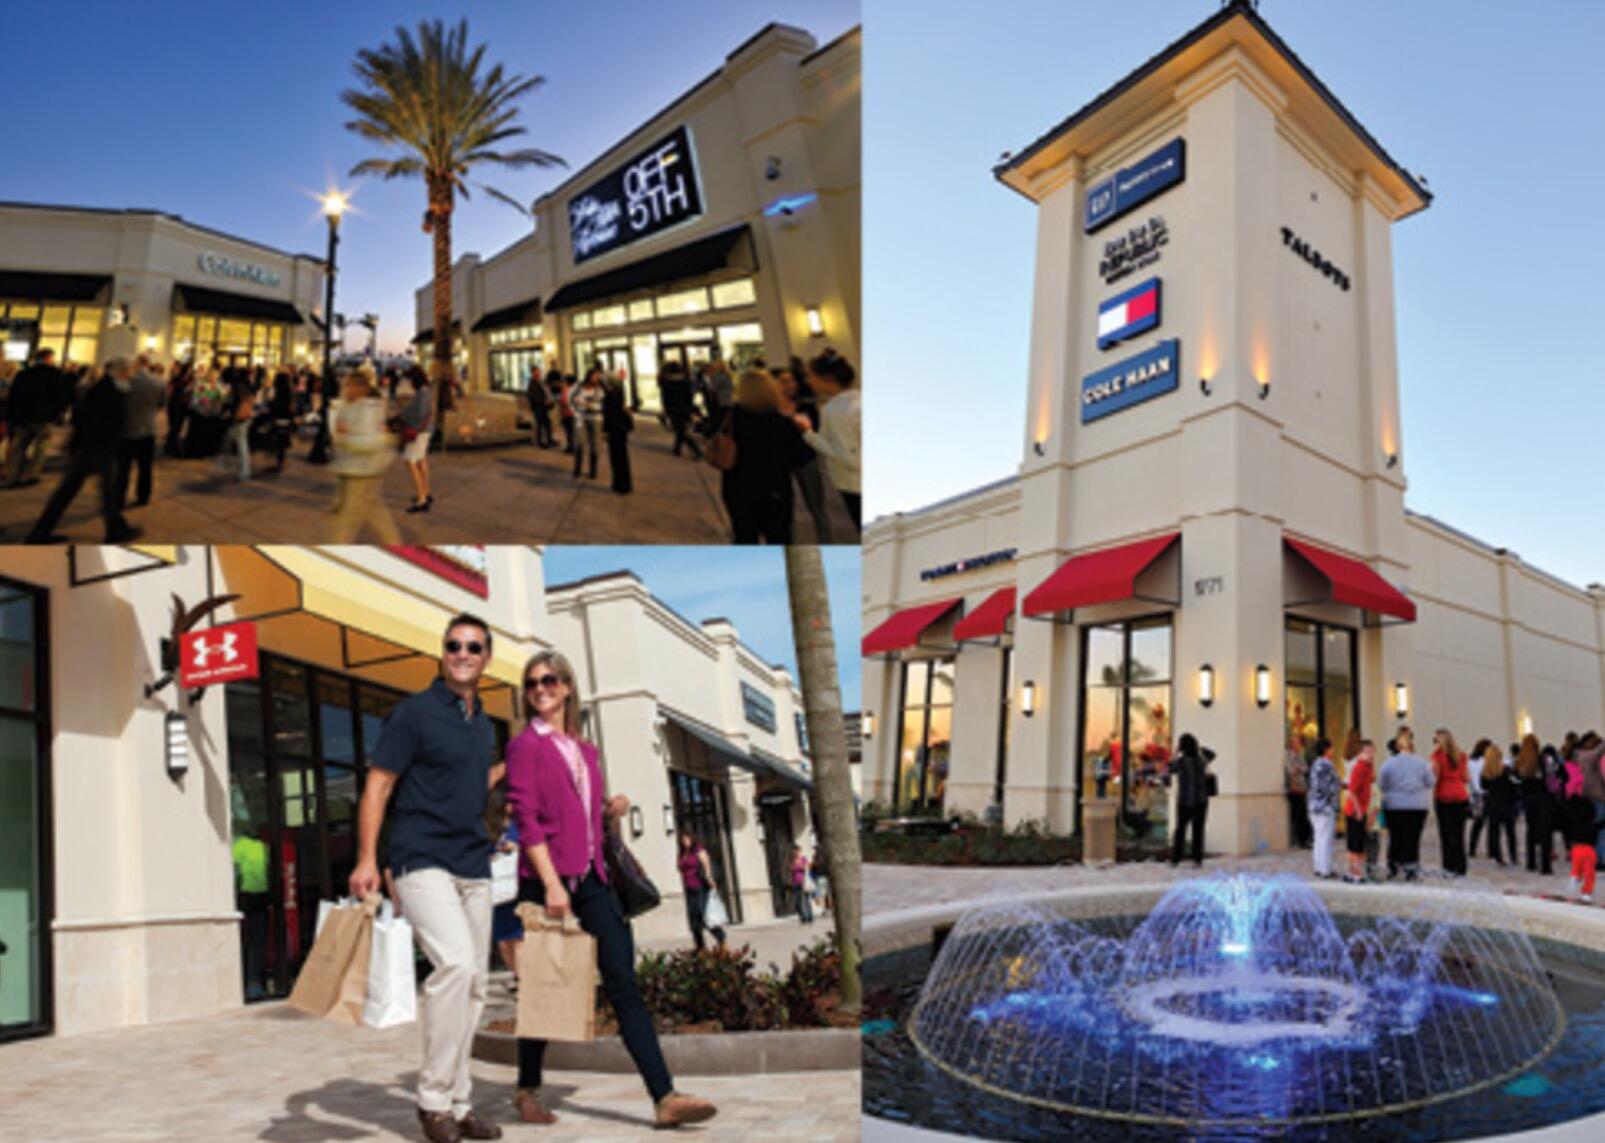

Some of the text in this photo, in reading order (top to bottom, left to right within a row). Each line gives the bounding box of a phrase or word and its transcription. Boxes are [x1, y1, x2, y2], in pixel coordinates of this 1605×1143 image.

[622, 140, 680, 199] OFF
[627, 174, 689, 231] 5TH
[1280, 226, 1351, 292] TALBOTS
[1083, 355, 1170, 405] COLE HAAN
